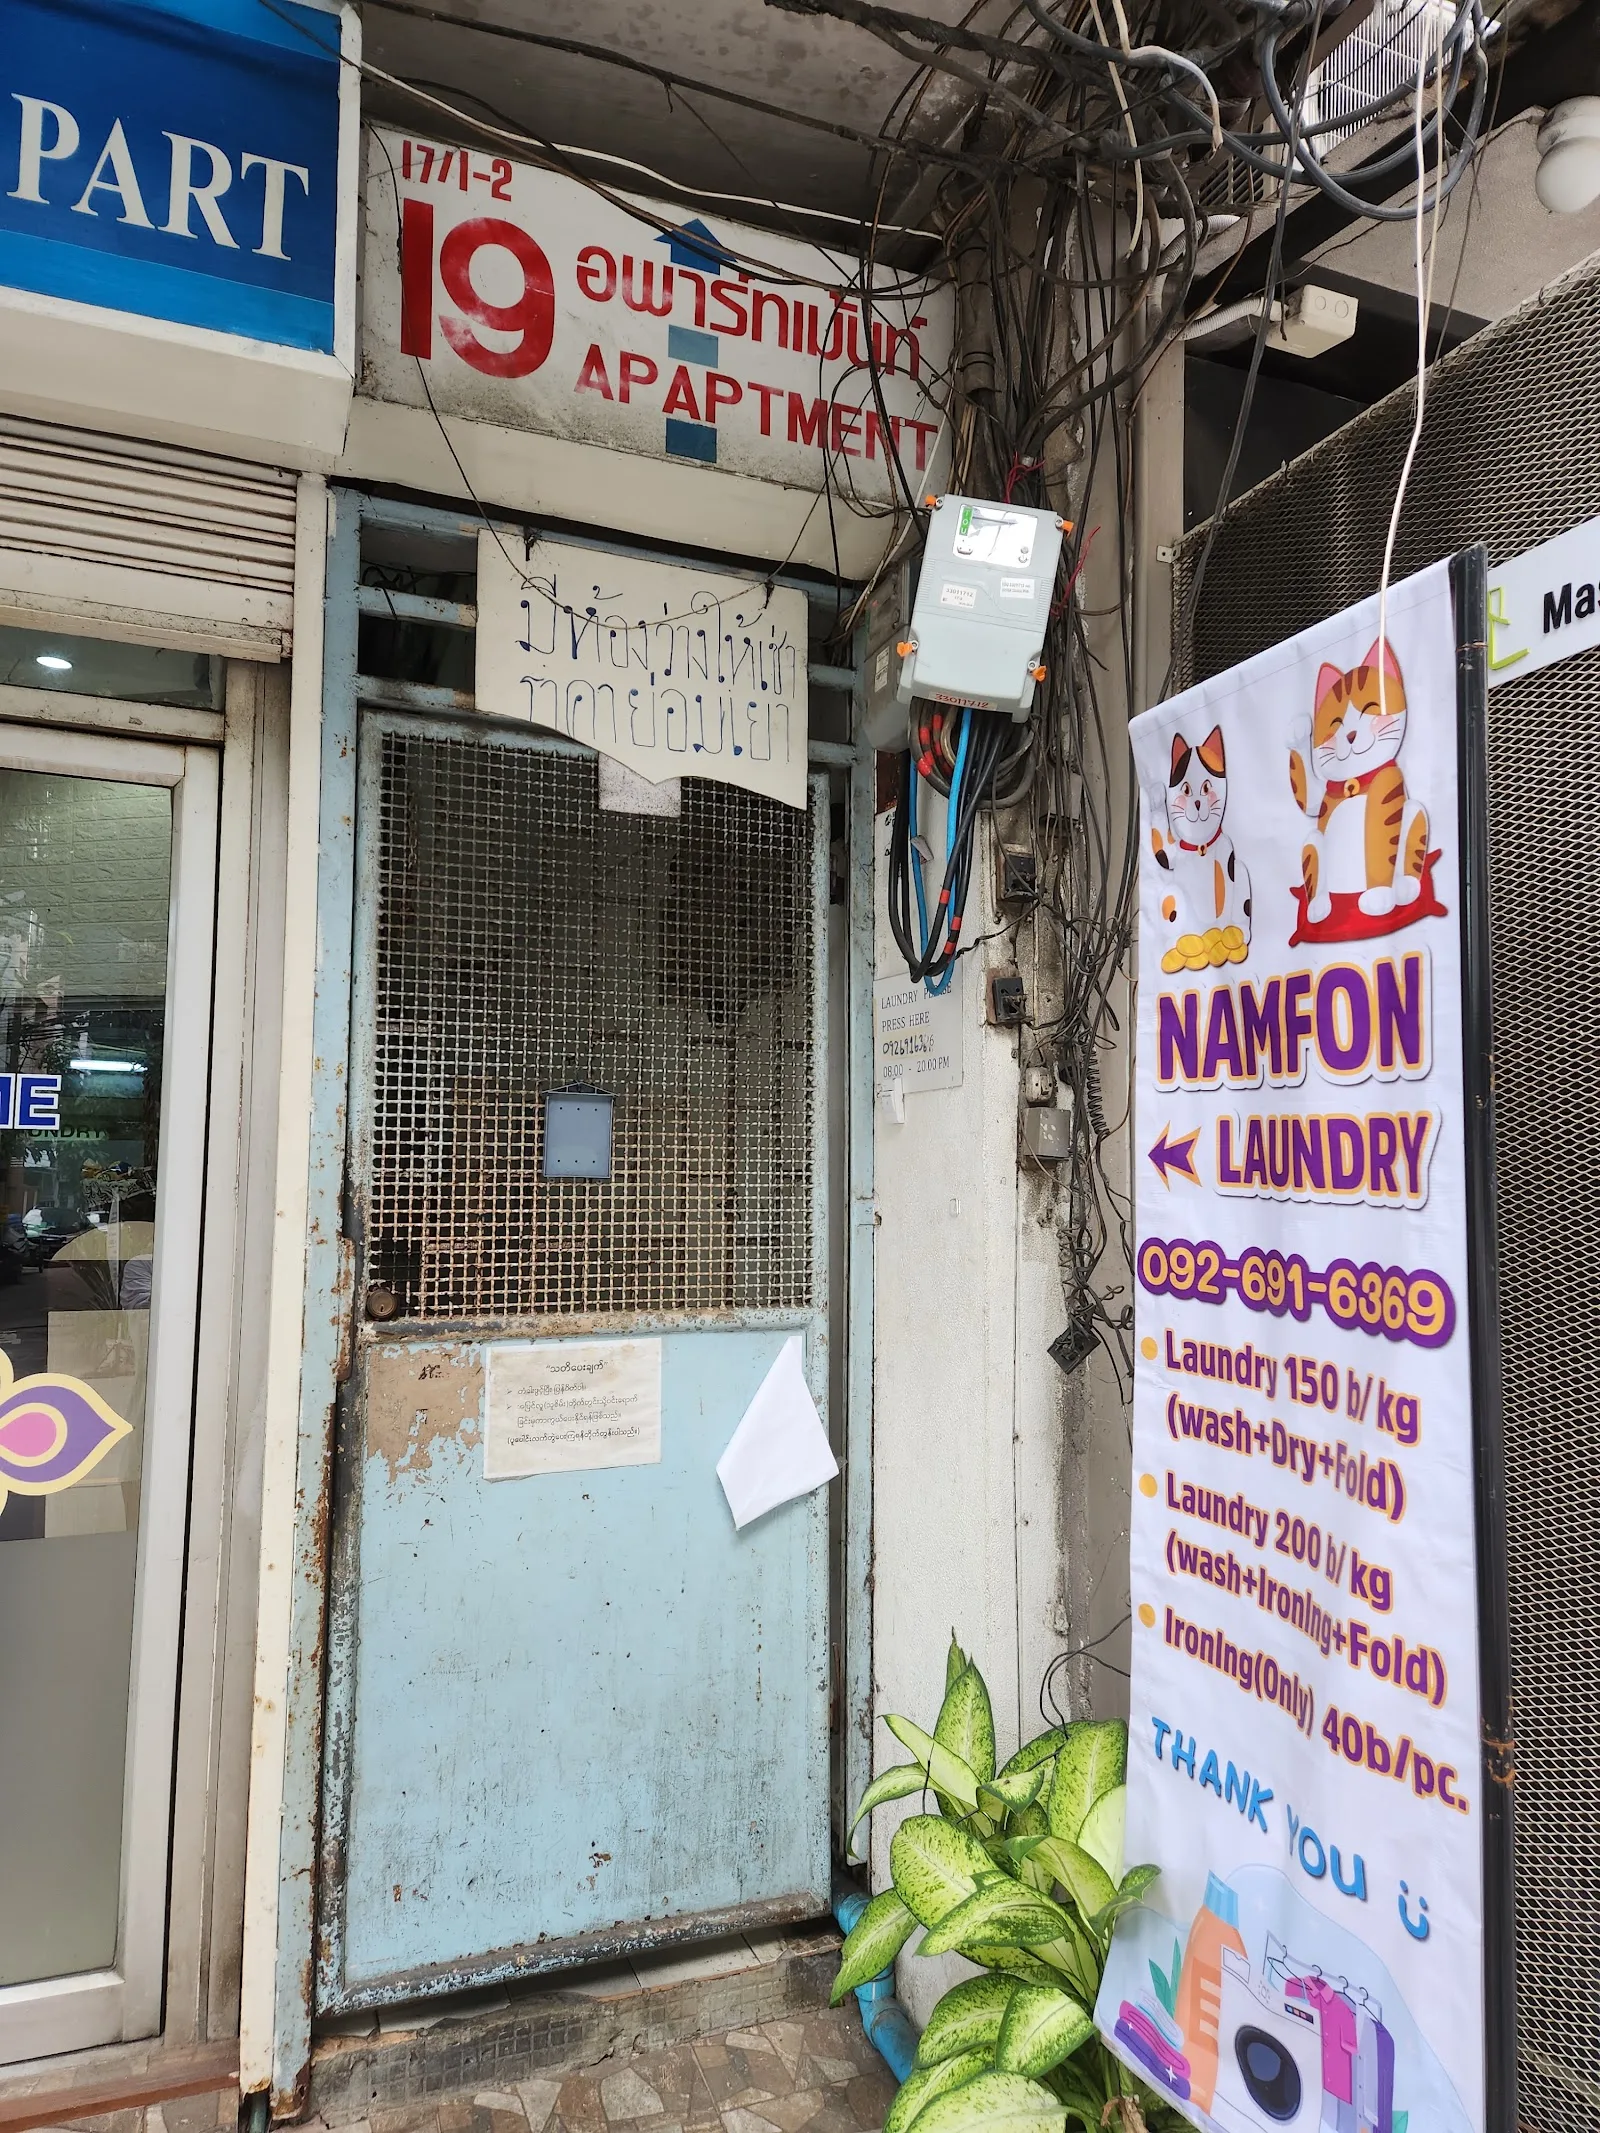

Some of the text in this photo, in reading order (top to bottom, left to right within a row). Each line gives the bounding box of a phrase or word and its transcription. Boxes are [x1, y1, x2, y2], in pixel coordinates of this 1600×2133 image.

[7, 93, 309, 261] PART
[402, 139, 512, 202] 17/1-2
[400, 197, 555, 379] 19
[1543, 582, 1600, 634] Ma
[881, 989, 918, 1009] LAUNDRY
[882, 1011, 930, 1032] PRESS HERE
[1156, 953, 1424, 1082] NAMFON
[0, 1072, 62, 1131] E
[1217, 1114, 1430, 1196] LAUNDRY
[1141, 1243, 1448, 1338] 092-691-6369
[1165, 1331, 1278, 1399] Laundry
[1284, 1355, 1339, 1411] 150
[1166, 1394, 1406, 1522] (wash+Dry+Fold)
[1165, 1471, 1268, 1548] Laundry
[1275, 1511, 1322, 1571] 200
[1322, 1704, 1469, 1814] 40b/pc.
[1152, 1716, 1367, 1902] THANK YOU
